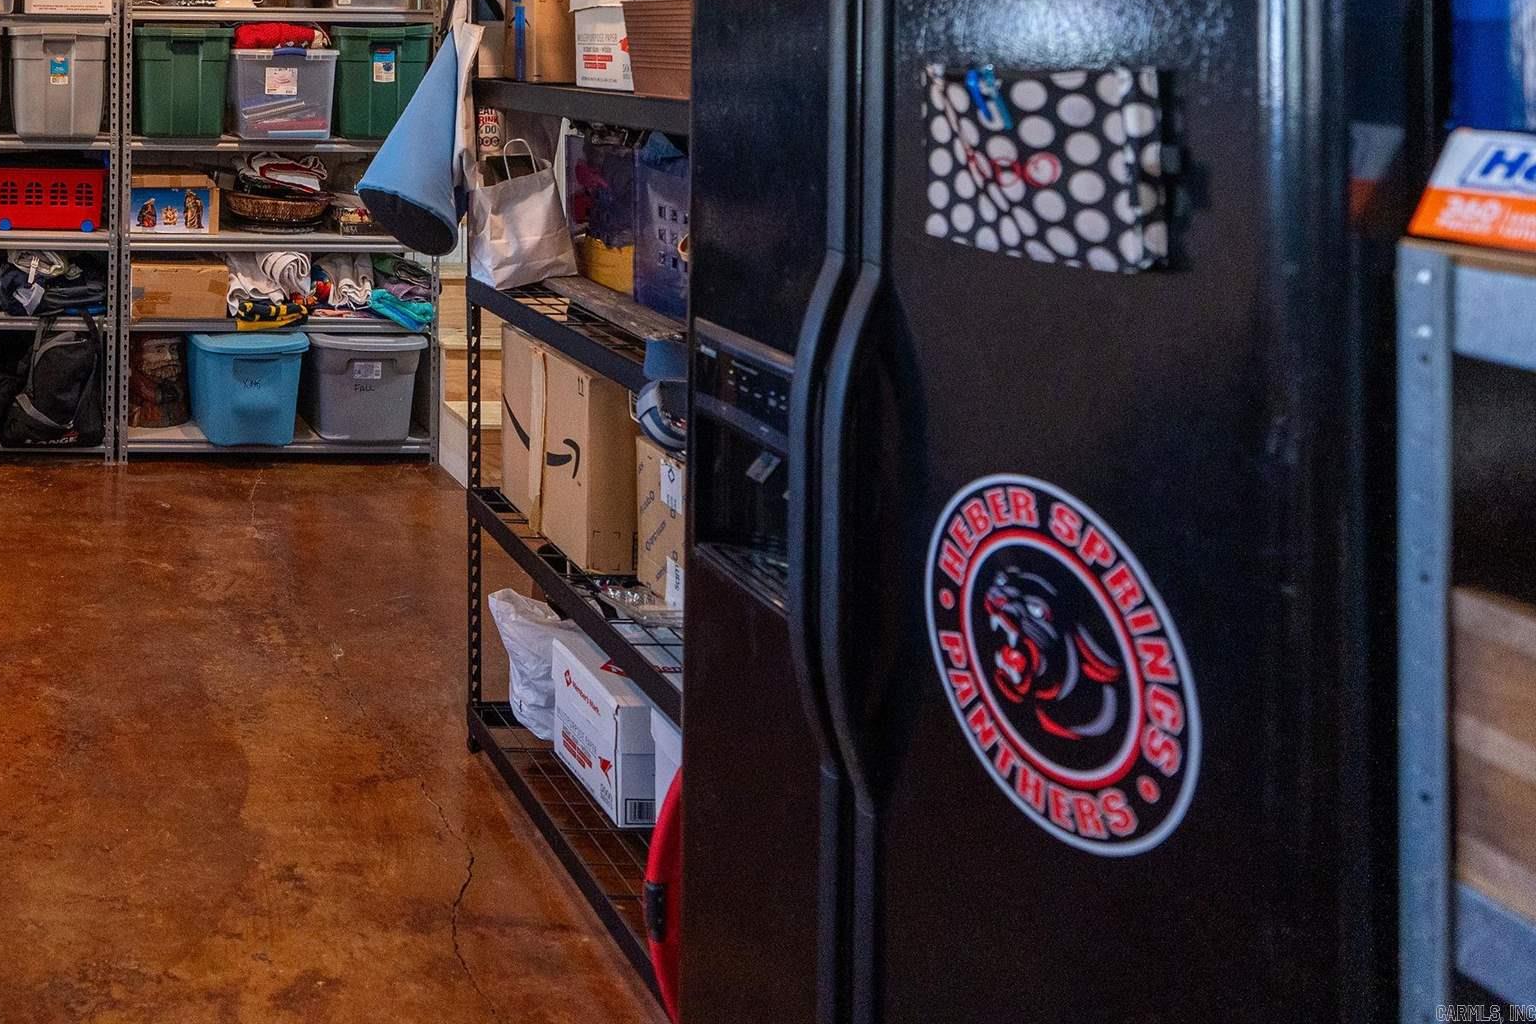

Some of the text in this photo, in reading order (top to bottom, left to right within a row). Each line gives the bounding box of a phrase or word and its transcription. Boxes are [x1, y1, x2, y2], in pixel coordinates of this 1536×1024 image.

[938, 487, 1184, 777] HEBER SPRINGS
[938, 630, 1138, 839] PANTHERS
